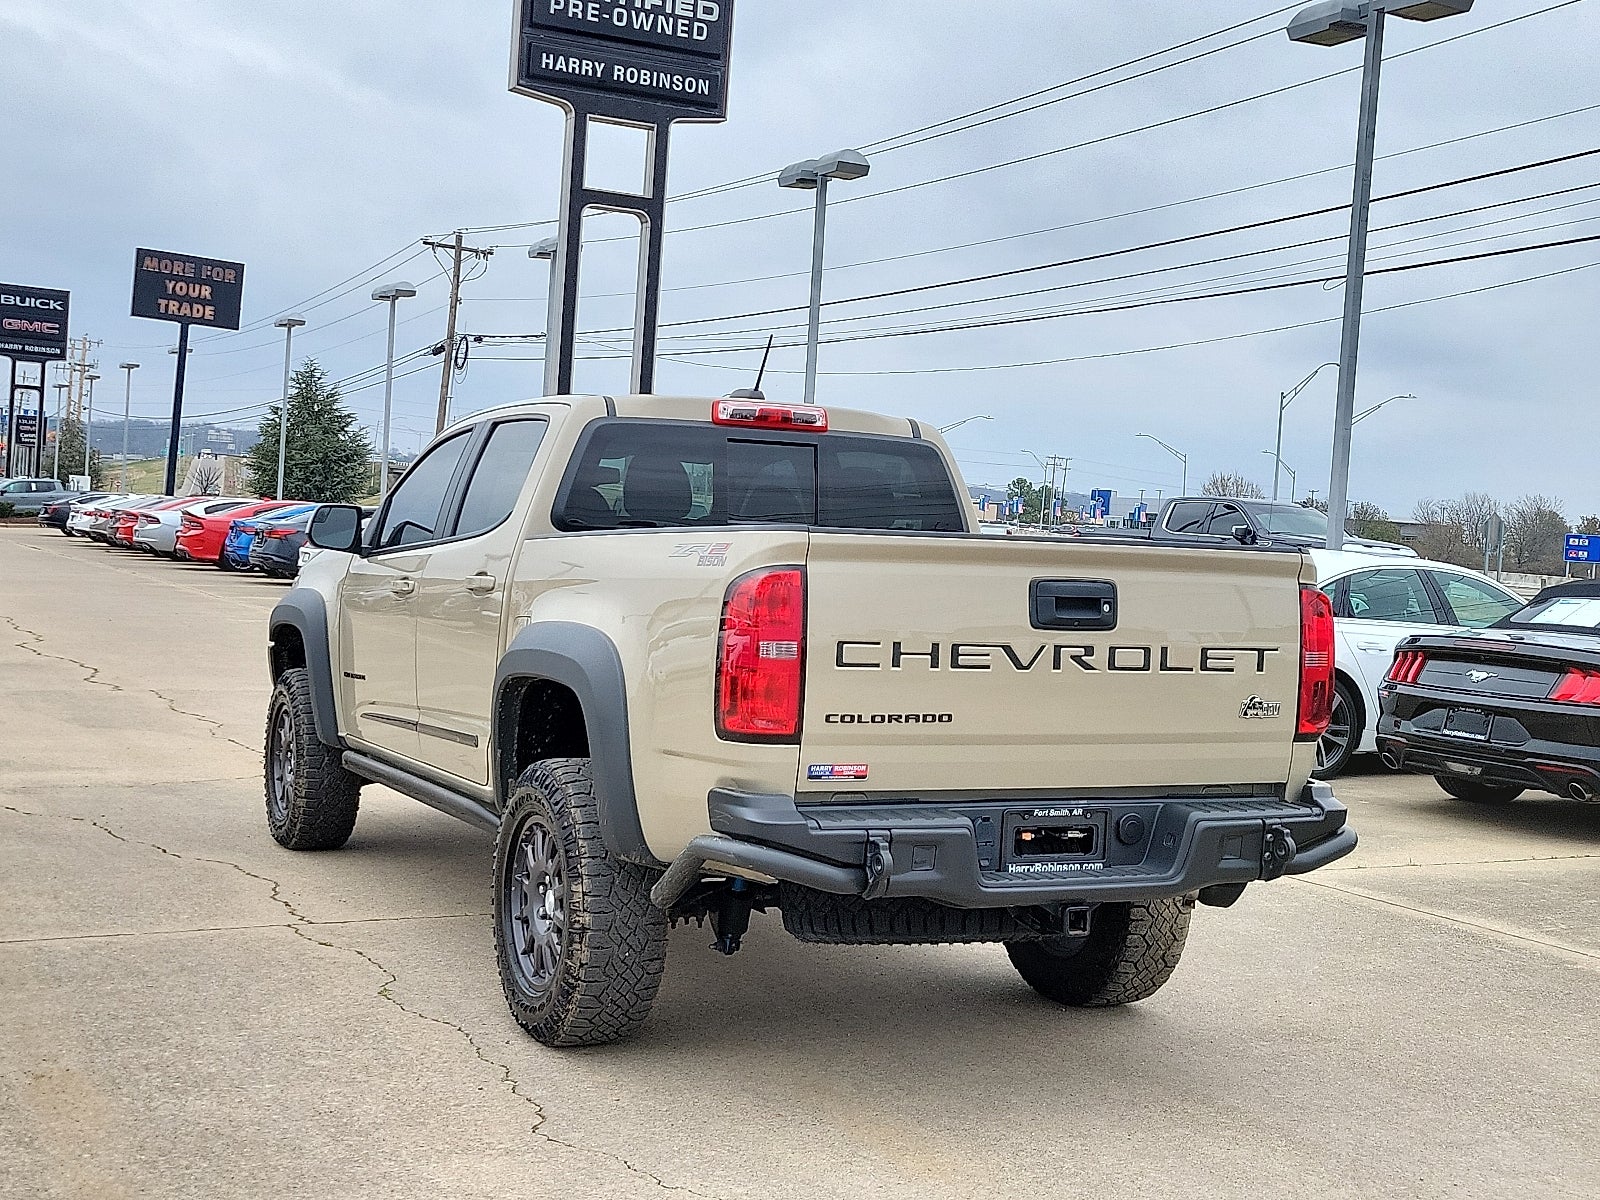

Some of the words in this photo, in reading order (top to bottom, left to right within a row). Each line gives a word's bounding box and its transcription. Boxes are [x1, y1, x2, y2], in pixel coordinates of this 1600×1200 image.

[549, 0, 708, 41] PRE-OWNED
[541, 52, 606, 78] HARRY
[613, 65, 710, 95] ROBINSON
[141, 256, 195, 277] MORE
[201, 265, 236, 283] FOR
[165, 279, 212, 300] YOUR
[0, 294, 65, 311] BUICK
[157, 298, 216, 320] TRADE
[3, 318, 60, 334] GMC
[668, 542, 733, 558] ZR2
[697, 555, 728, 567] BISON
[834, 640, 1280, 673] CHEVROLET
[824, 712, 954, 724] COLORADO
[1033, 809, 1048, 817] Fort
[1072, 808, 1083, 816] AR
